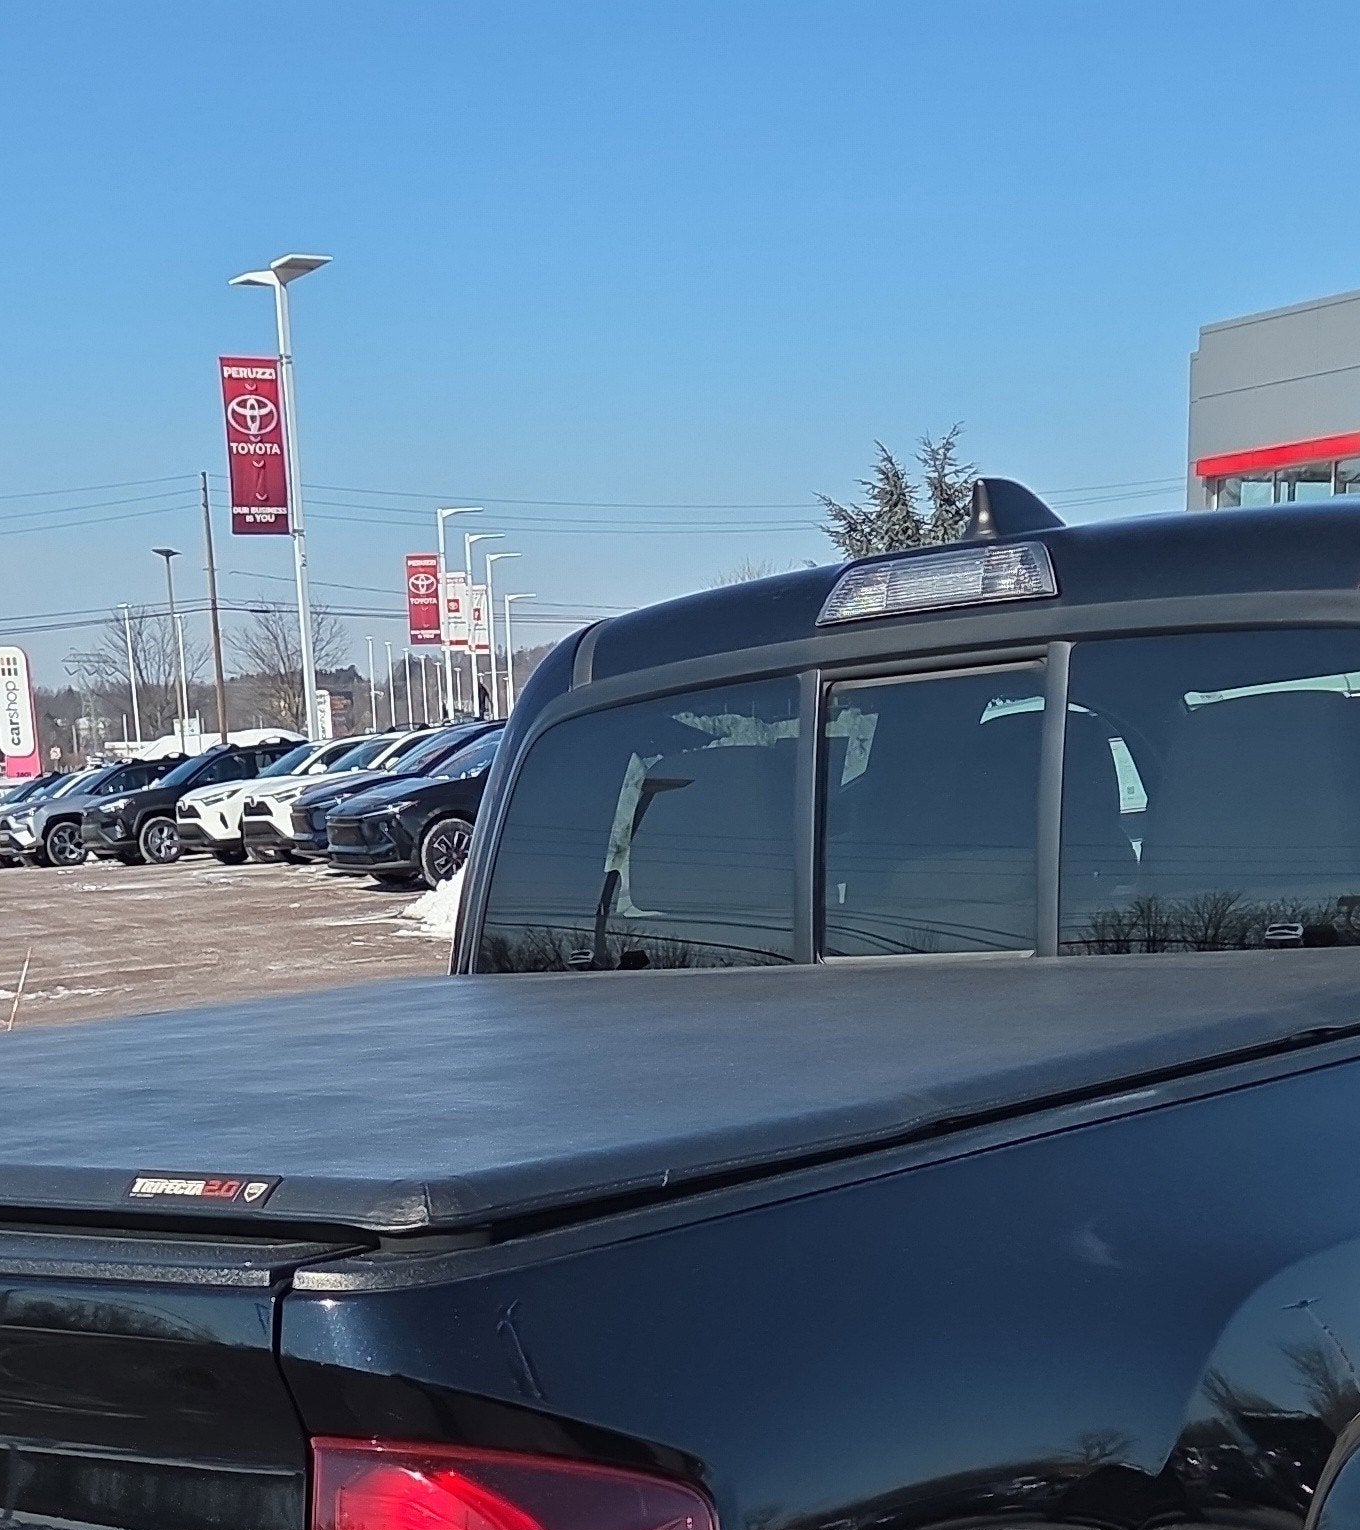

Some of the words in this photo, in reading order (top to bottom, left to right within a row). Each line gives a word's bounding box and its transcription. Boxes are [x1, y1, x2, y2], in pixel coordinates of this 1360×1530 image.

[223, 366, 276, 380] PERUZZI
[230, 442, 281, 455] TOYOTA
[233, 507, 250, 515] OUR
[251, 507, 288, 515] BUSINESS
[255, 513, 276, 523] YOU
[409, 597, 438, 605] TOYOTA
[5, 680, 22, 746] carshop
[132, 1178, 206, 1195] TRIFECTA
